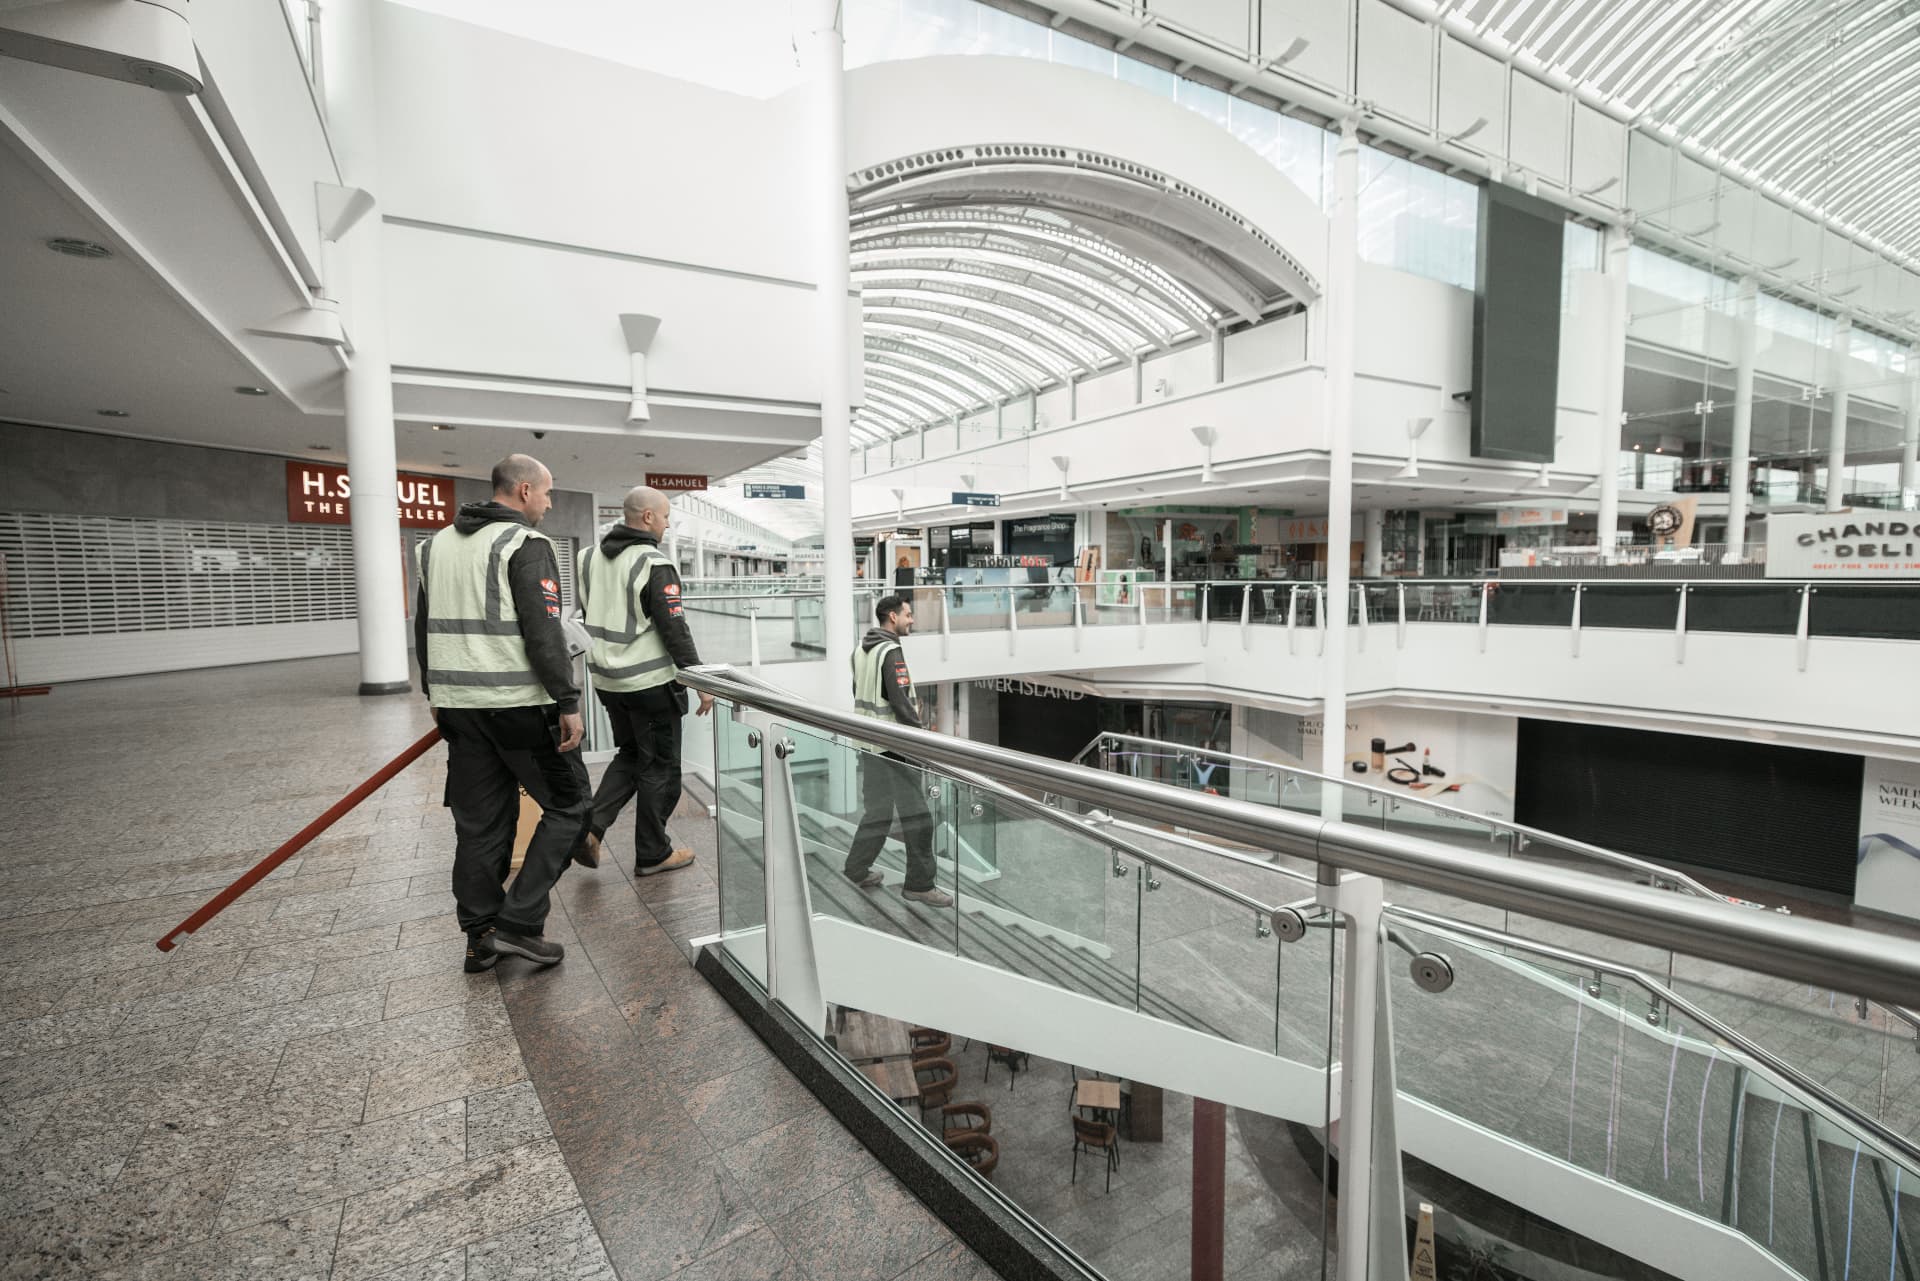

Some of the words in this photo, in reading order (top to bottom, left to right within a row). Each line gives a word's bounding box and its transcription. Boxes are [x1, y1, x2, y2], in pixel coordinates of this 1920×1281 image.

[302, 470, 447, 507] H.SUEL
[650, 477, 705, 488] H.SAMUEL
[304, 501, 344, 515] THE
[1013, 525, 1023, 534] The
[1024, 524, 1050, 534] Fragrance
[1051, 521, 1066, 531] Shop
[1835, 543, 1913, 558] DELI
[1019, 679, 1085, 701] ISLAND
